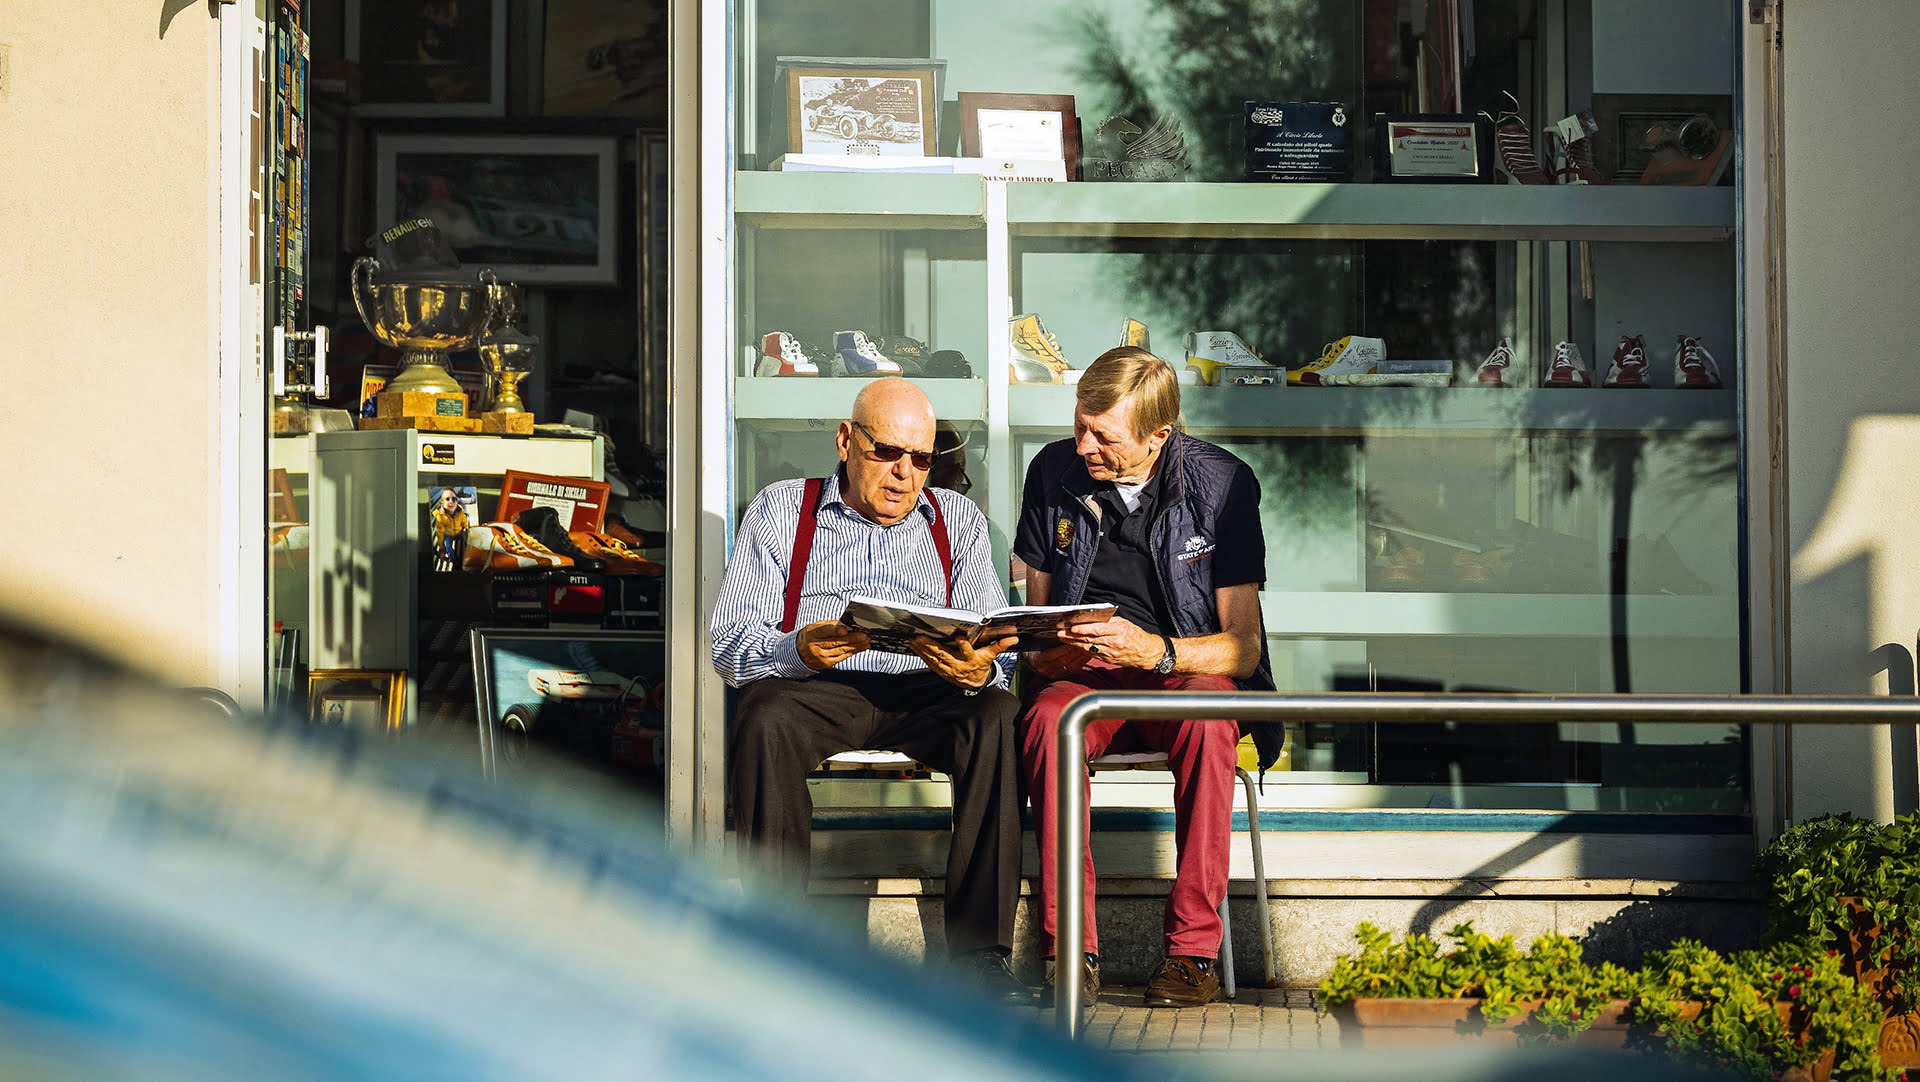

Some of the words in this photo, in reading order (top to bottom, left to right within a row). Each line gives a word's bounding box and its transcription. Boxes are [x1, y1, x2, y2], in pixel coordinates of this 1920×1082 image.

[1093, 160, 1177, 178] PEGASO
[526, 481, 558, 497] GIORNALE
[557, 485, 565, 497] DI
[565, 486, 587, 500] SICILIA
[1177, 551, 1198, 560] STATE
[1204, 544, 1216, 553] ART
[570, 576, 588, 584] PITTI
